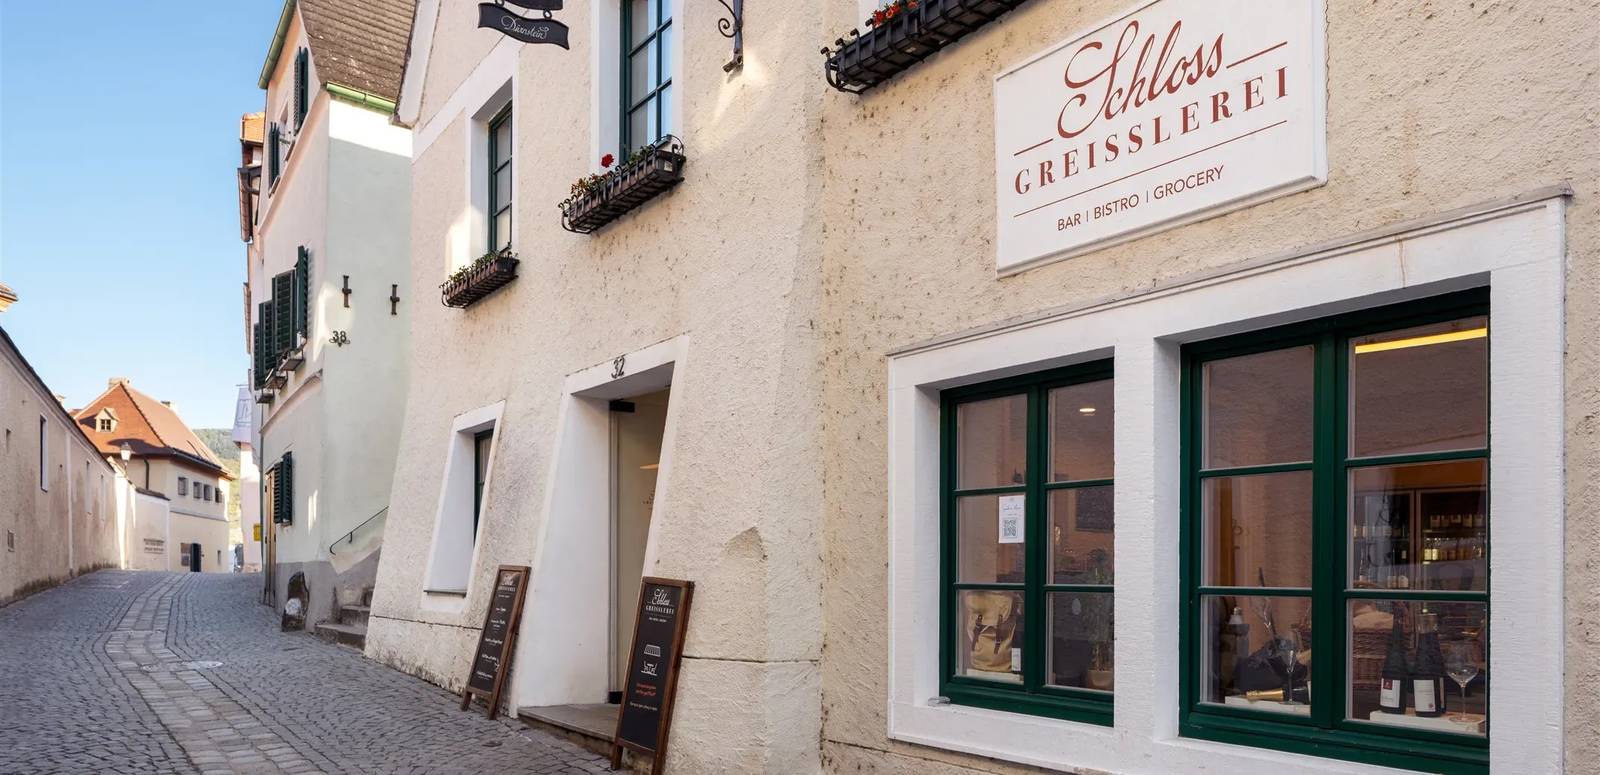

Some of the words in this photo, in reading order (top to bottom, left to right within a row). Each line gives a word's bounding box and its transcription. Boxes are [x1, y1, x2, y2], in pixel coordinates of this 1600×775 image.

[1057, 20, 1223, 139] Schloss
[1015, 66, 1288, 195] GREISSLEREI
[1057, 213, 1082, 231] BAR
[1093, 194, 1139, 219] BISTRO
[1154, 165, 1225, 201] GROCERY
[332, 330, 347, 344] 38
[611, 355, 625, 379] 32
